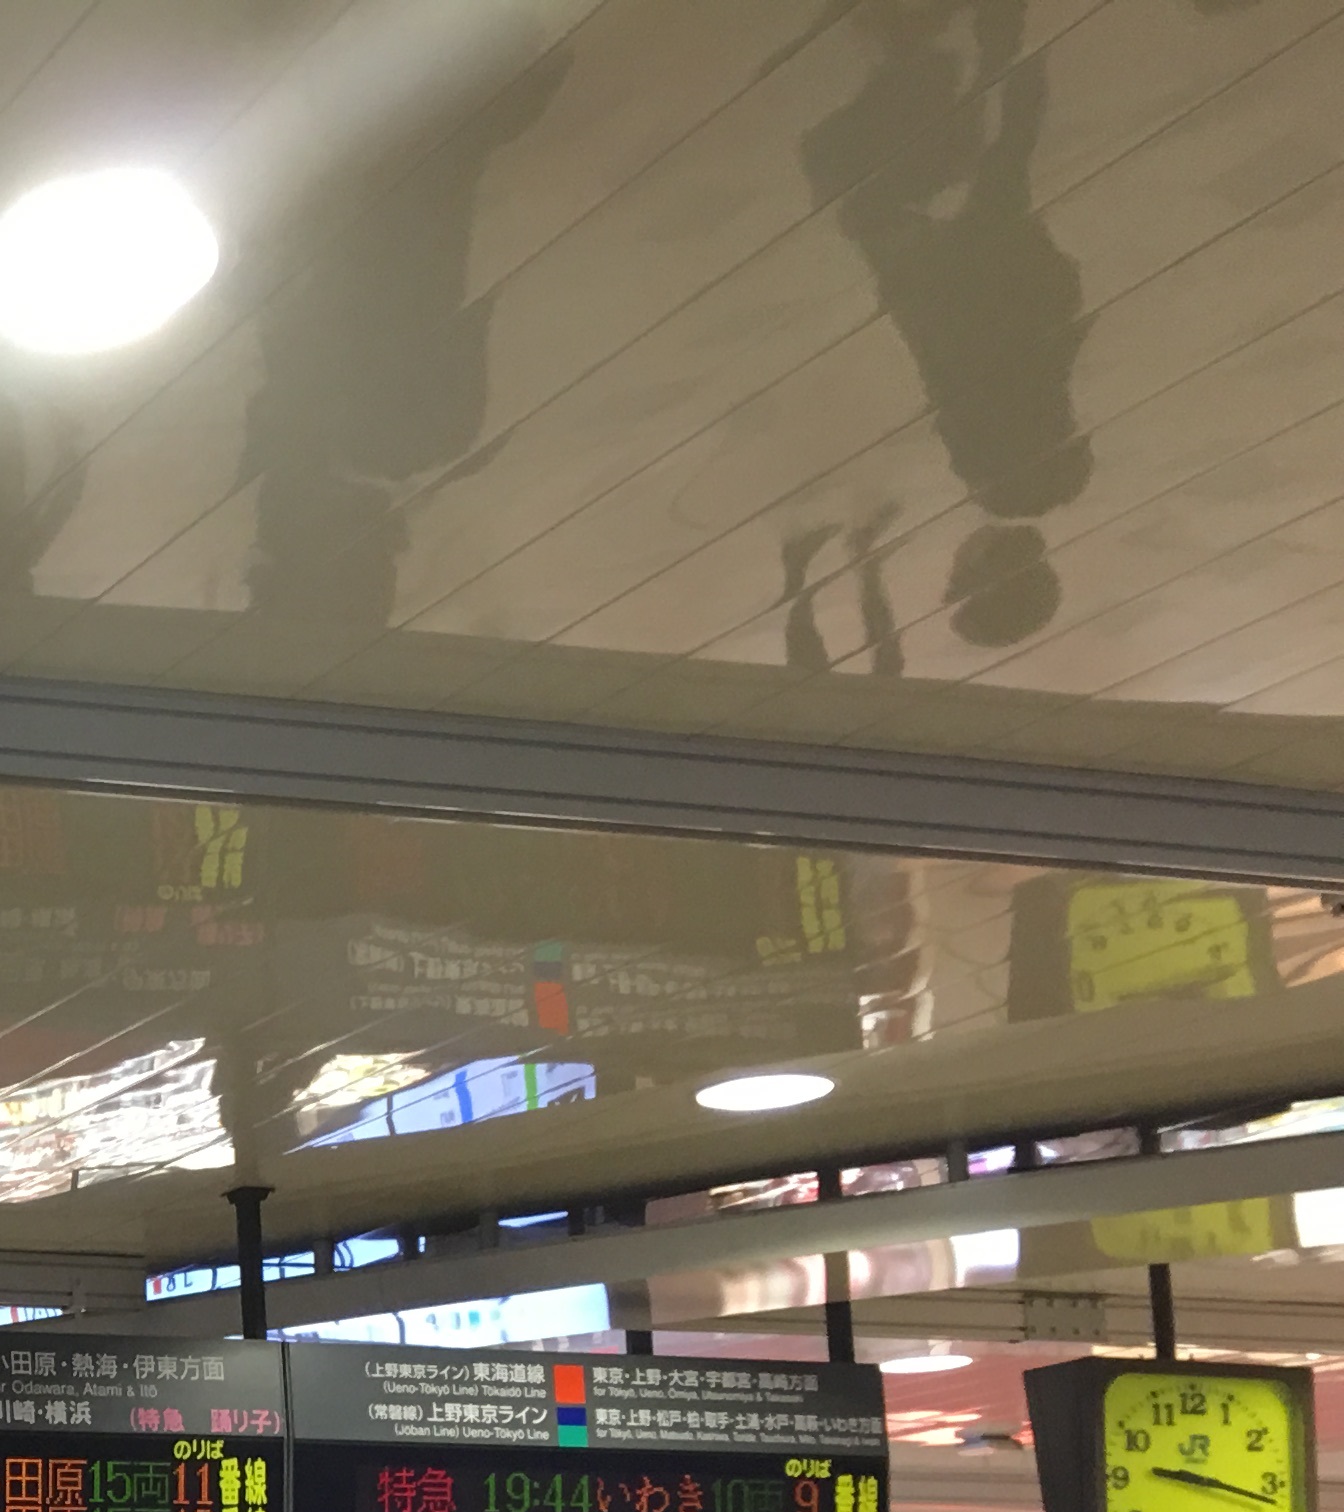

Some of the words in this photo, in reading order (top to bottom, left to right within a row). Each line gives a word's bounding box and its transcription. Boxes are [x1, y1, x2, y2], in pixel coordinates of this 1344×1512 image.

[364, 1361, 470, 1381] (上野東京ライン)
[472, 1363, 546, 1384] 東海道線
[12, 1380, 79, 1398] Odawara,
[82, 1382, 123, 1397] Atami
[452, 1383, 479, 1397] Line)
[525, 1386, 547, 1398] Line
[426, 1402, 549, 1425] 上野東京ライン
[1152, 1402, 1176, 1426] 11
[1180, 1392, 1207, 1416] 12
[1220, 1402, 1232, 1426] 1
[433, 1424, 460, 1439] Line)
[527, 1428, 550, 1440] Line
[1124, 1429, 1151, 1452] 10
[1246, 1428, 1265, 1452] 2
[174, 1439, 224, 1460] のりば
[785, 1459, 832, 1479] のりば
[1111, 1466, 1130, 1490] 9
[1261, 1472, 1279, 1495] 3
